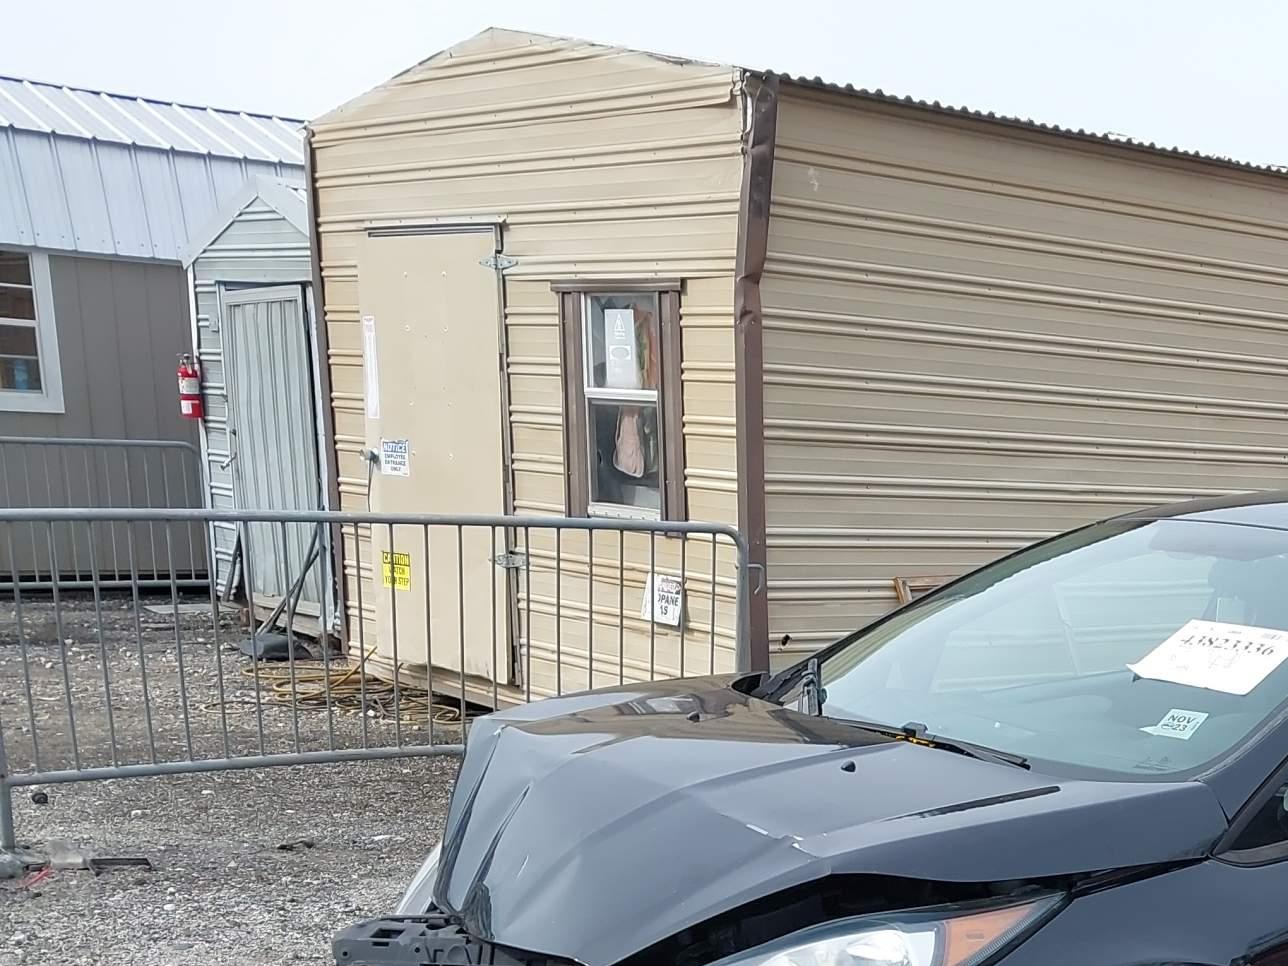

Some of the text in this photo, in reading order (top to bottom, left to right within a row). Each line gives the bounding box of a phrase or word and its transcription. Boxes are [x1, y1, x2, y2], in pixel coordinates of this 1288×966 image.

[384, 443, 406, 452] NOTICE
[1180, 634, 1275, 656] 43823336
[1167, 714, 1196, 724] NOV
